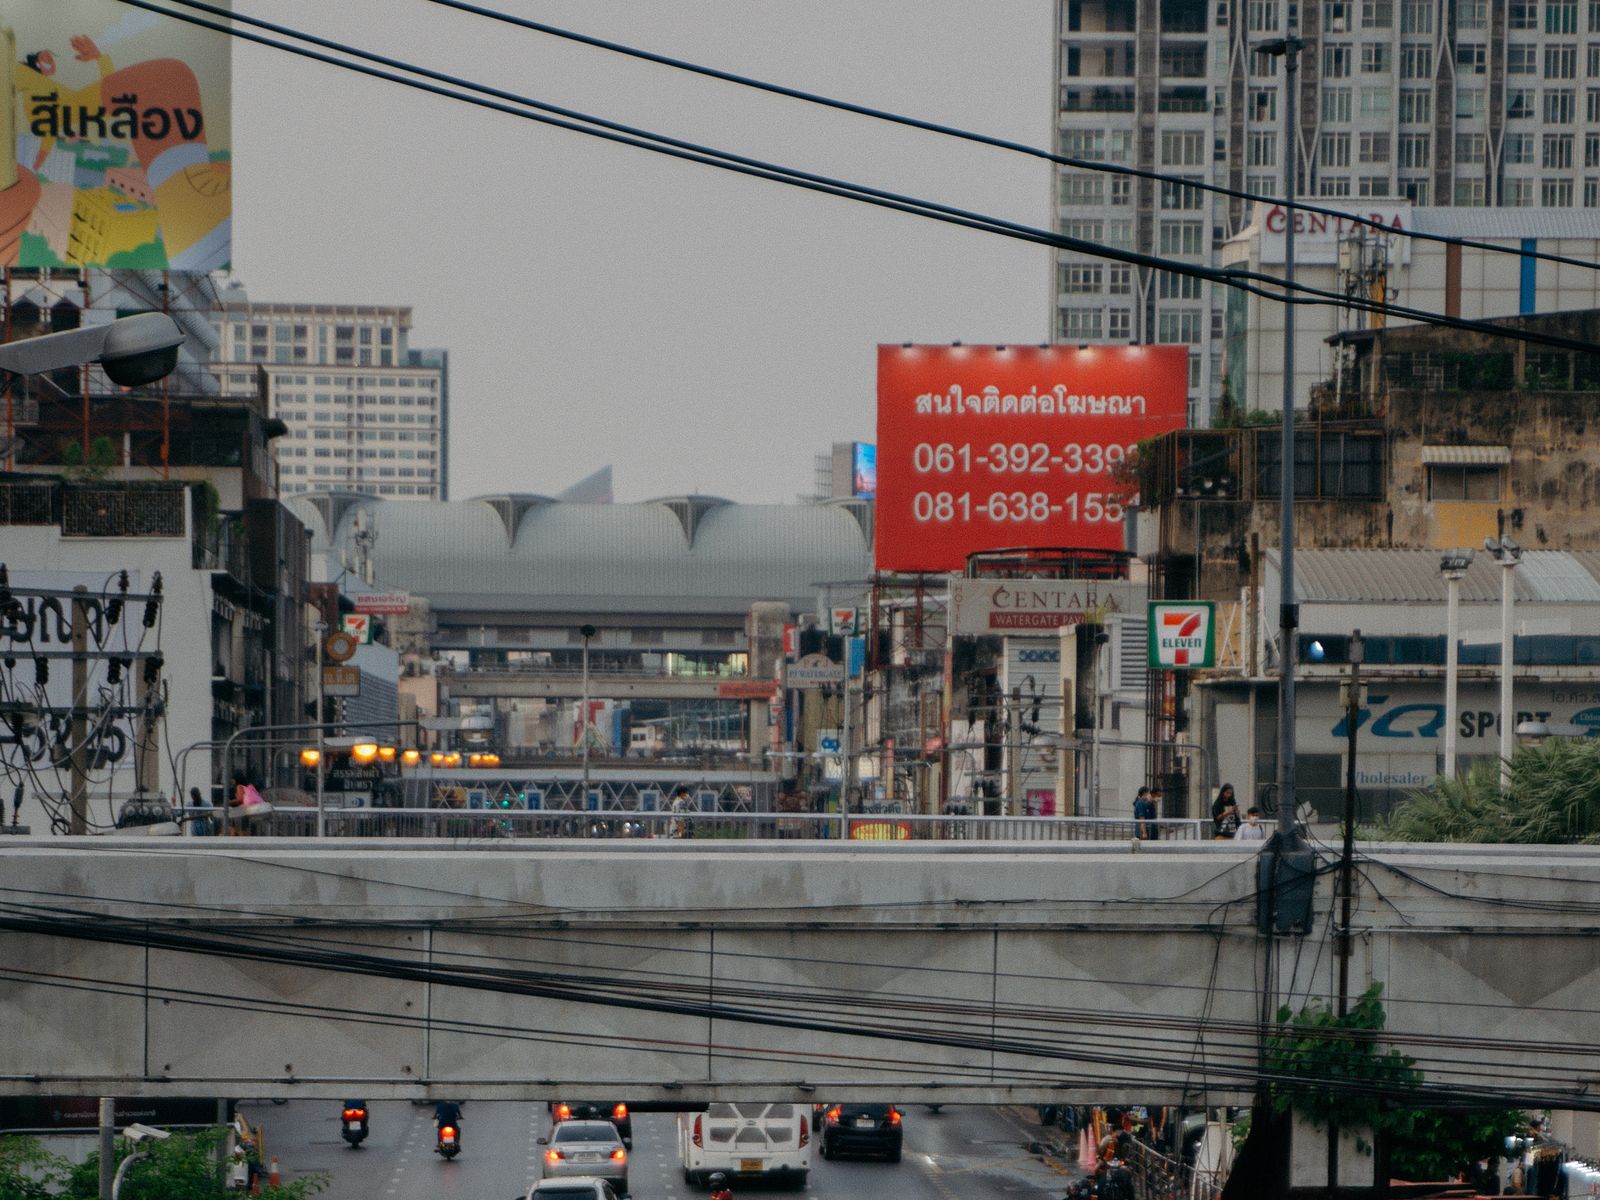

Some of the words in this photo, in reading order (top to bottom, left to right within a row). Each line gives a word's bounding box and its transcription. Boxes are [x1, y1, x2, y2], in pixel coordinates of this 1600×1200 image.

[30, 92, 204, 141] สีเหลือง
[1266, 205, 1403, 234] CENTARA
[915, 384, 1146, 415] สนใจติดต่อโฆษณา
[992, 586, 1117, 610] CENTARA
[995, 616, 1058, 626] WATERGATE
